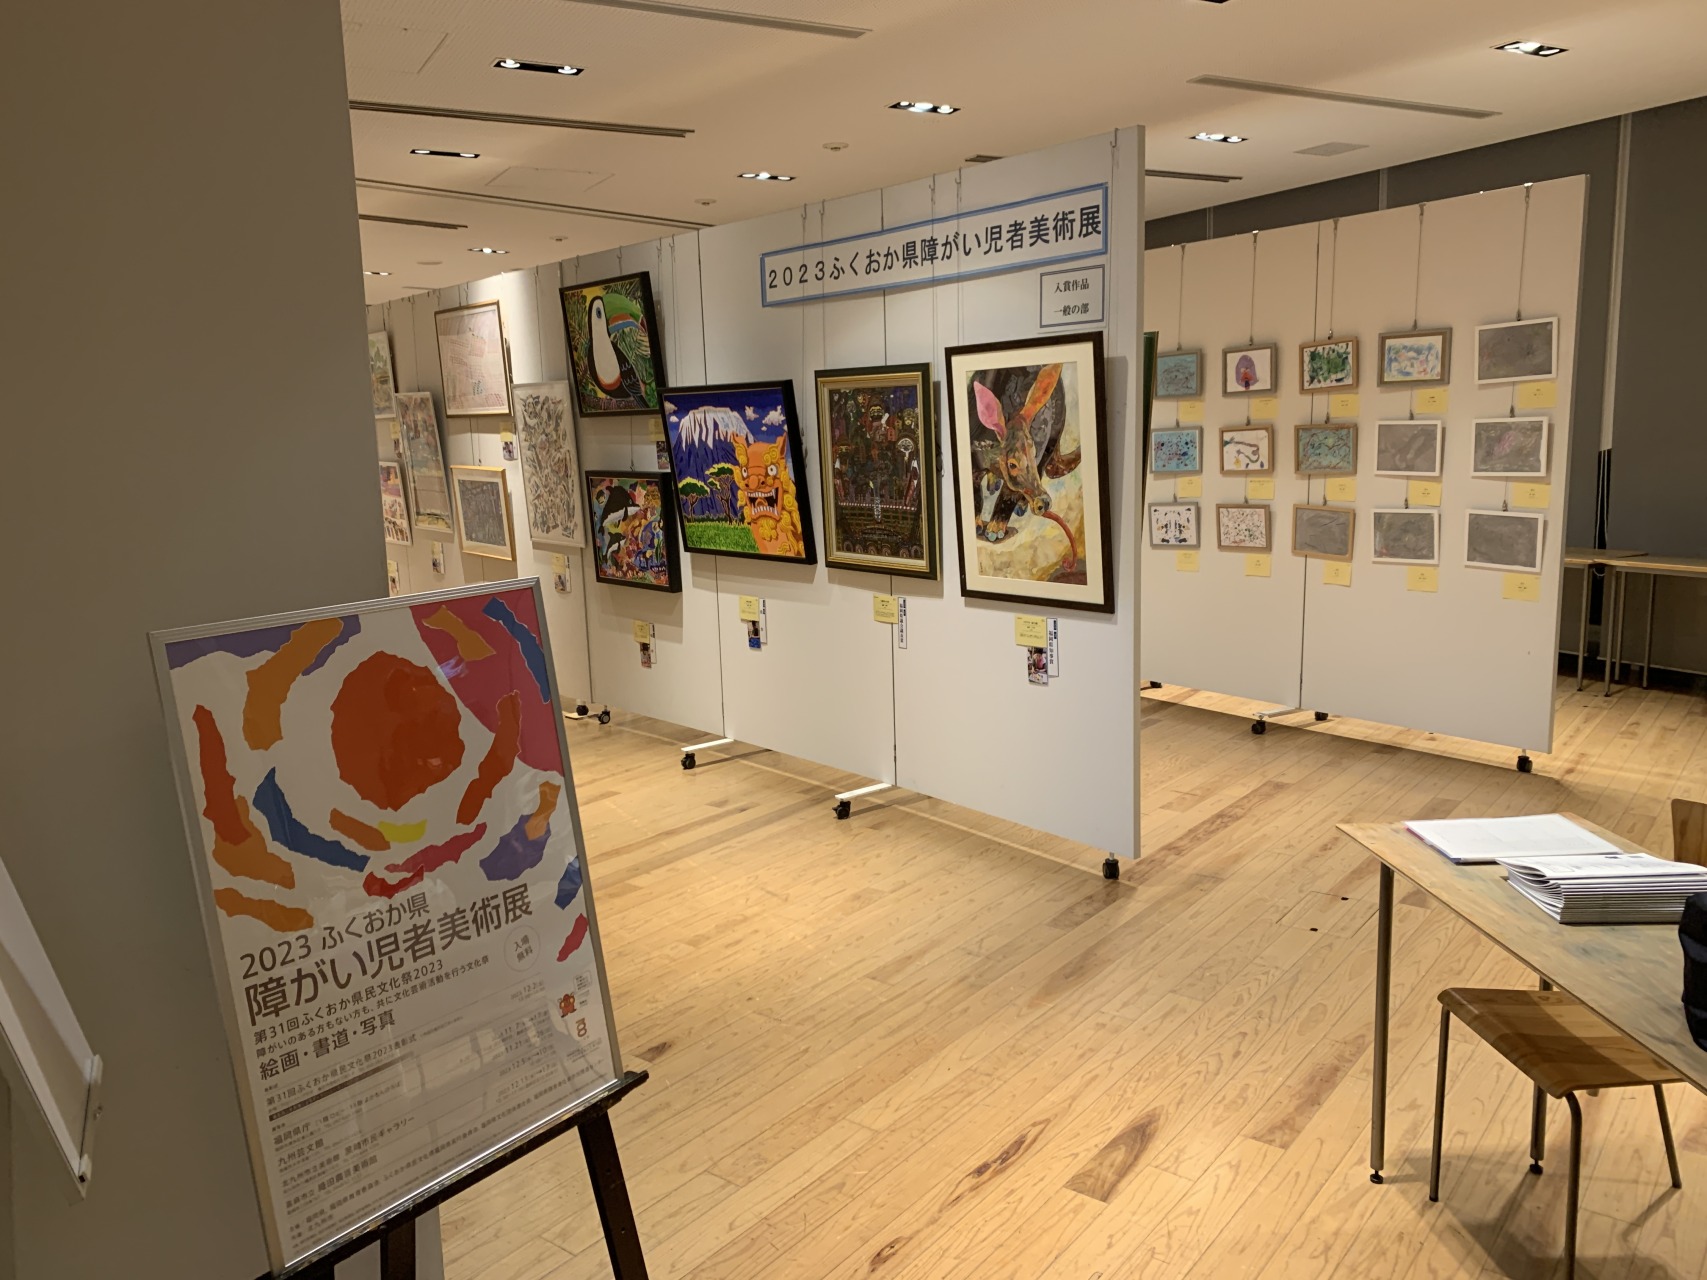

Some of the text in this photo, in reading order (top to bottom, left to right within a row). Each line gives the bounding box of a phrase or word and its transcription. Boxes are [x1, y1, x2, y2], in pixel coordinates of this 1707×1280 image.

[768, 204, 1103, 289] 2023ふくおか県障がい児者美術展
[1054, 278, 1090, 293] 入賞作品
[1054, 303, 1090, 316] 一般の部
[238, 891, 430, 982] 2023 ふくおか県
[243, 881, 534, 1027] 障がい児者美術展
[513, 932, 531, 952] 入場
[252, 957, 444, 1046] 第31回ふくおか県民文化祭2023
[255, 955, 490, 1060] 障がいのある方もない方も、共に文化芸術活動を行う文化祭
[258, 1007, 396, 1082] 絵画・書道・写真
